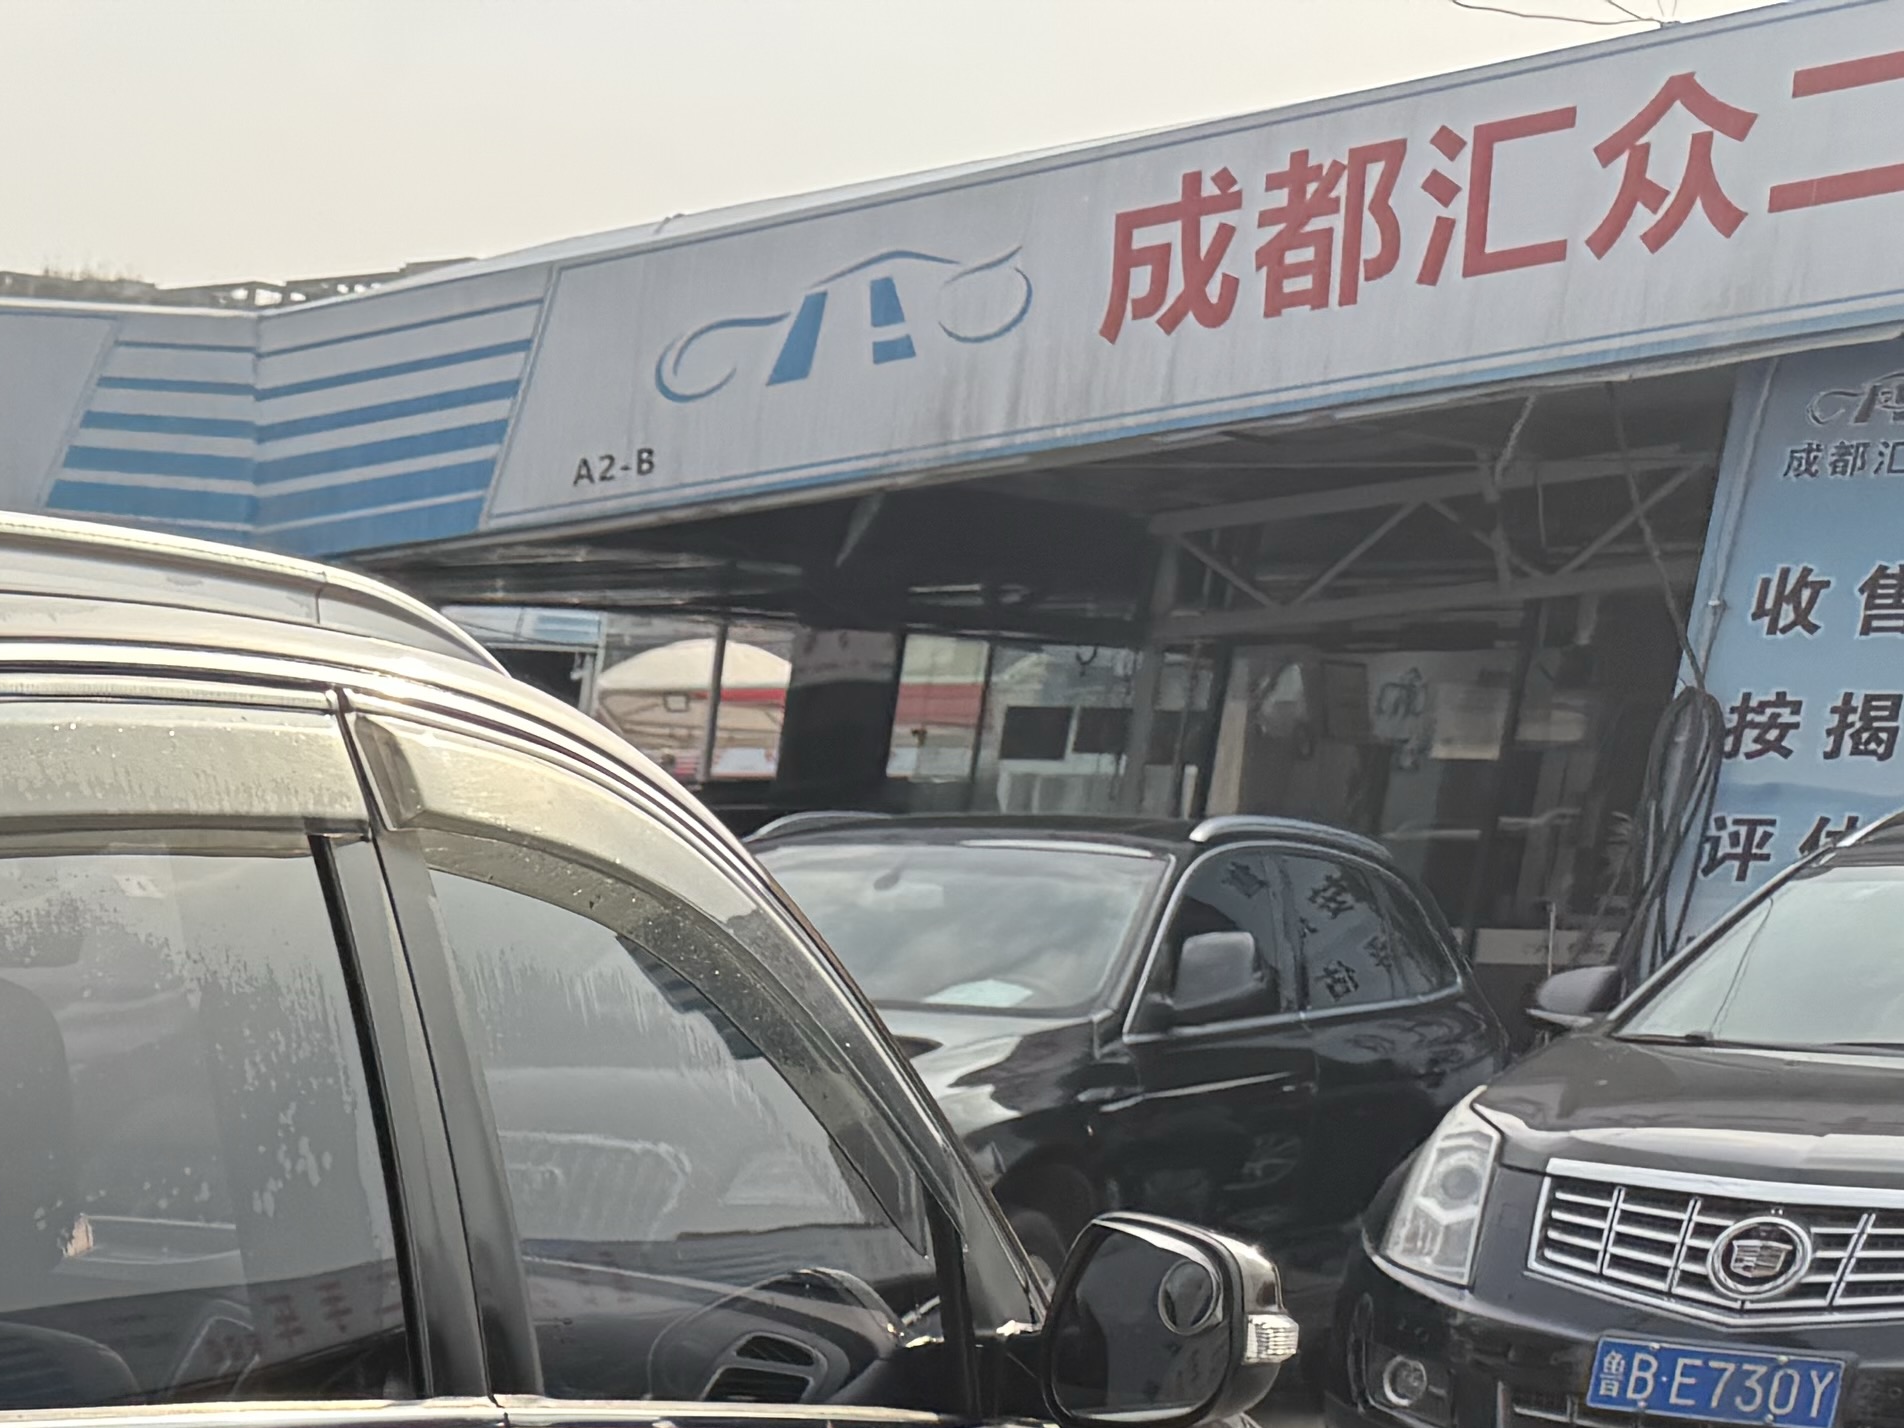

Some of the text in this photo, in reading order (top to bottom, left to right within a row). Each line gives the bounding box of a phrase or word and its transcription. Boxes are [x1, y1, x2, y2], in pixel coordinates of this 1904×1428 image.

[1098, 50, 1904, 346] 成都汇众二
[572, 448, 656, 488] A2-B
[1783, 439, 1904, 480] 成都汇
[1723, 690, 1903, 763] 按揭
